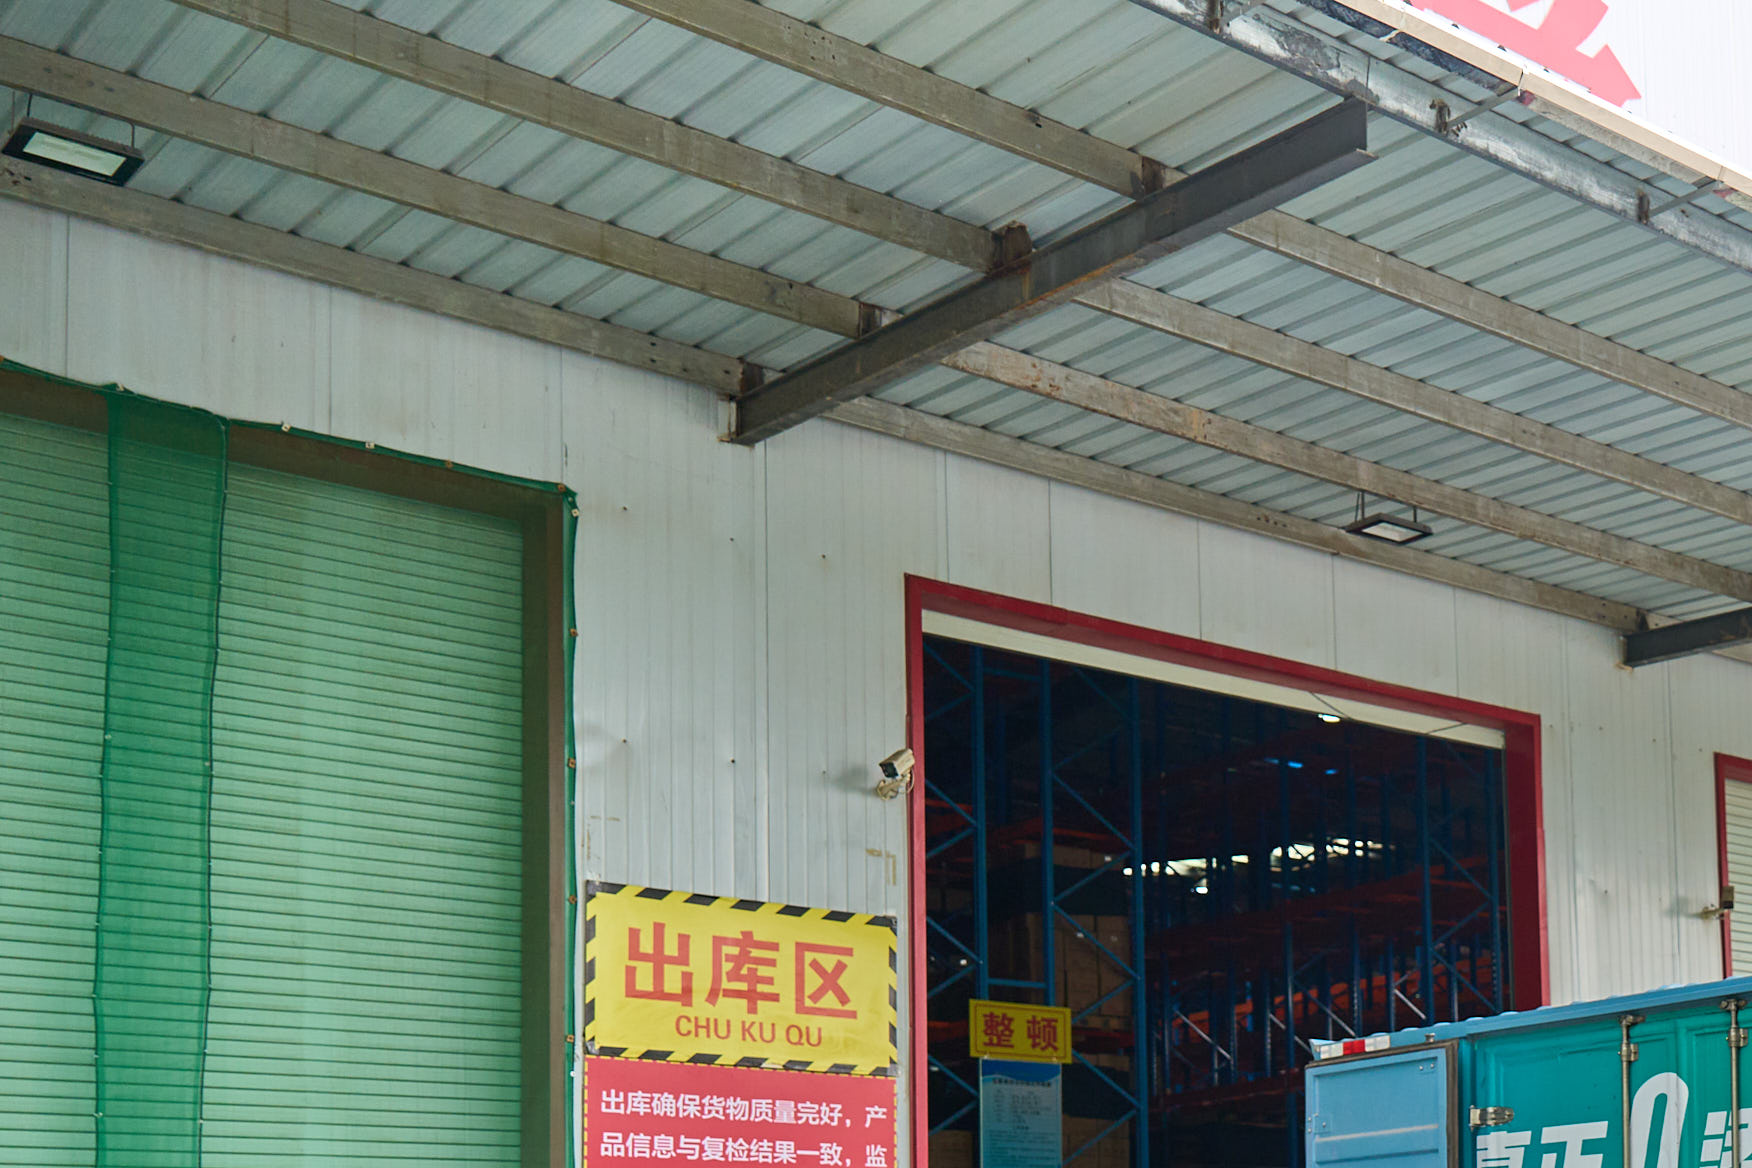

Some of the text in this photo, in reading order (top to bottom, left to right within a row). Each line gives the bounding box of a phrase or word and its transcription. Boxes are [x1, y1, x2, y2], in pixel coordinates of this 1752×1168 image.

[624, 921, 858, 1020] 出库区
[674, 1015, 823, 1049] CHU KU QU
[982, 1010, 1060, 1053] 整顿
[600, 1089, 888, 1130] 出库确保货物质量完好，产
[599, 1131, 888, 1168] 品信息与复检结果一致，监
